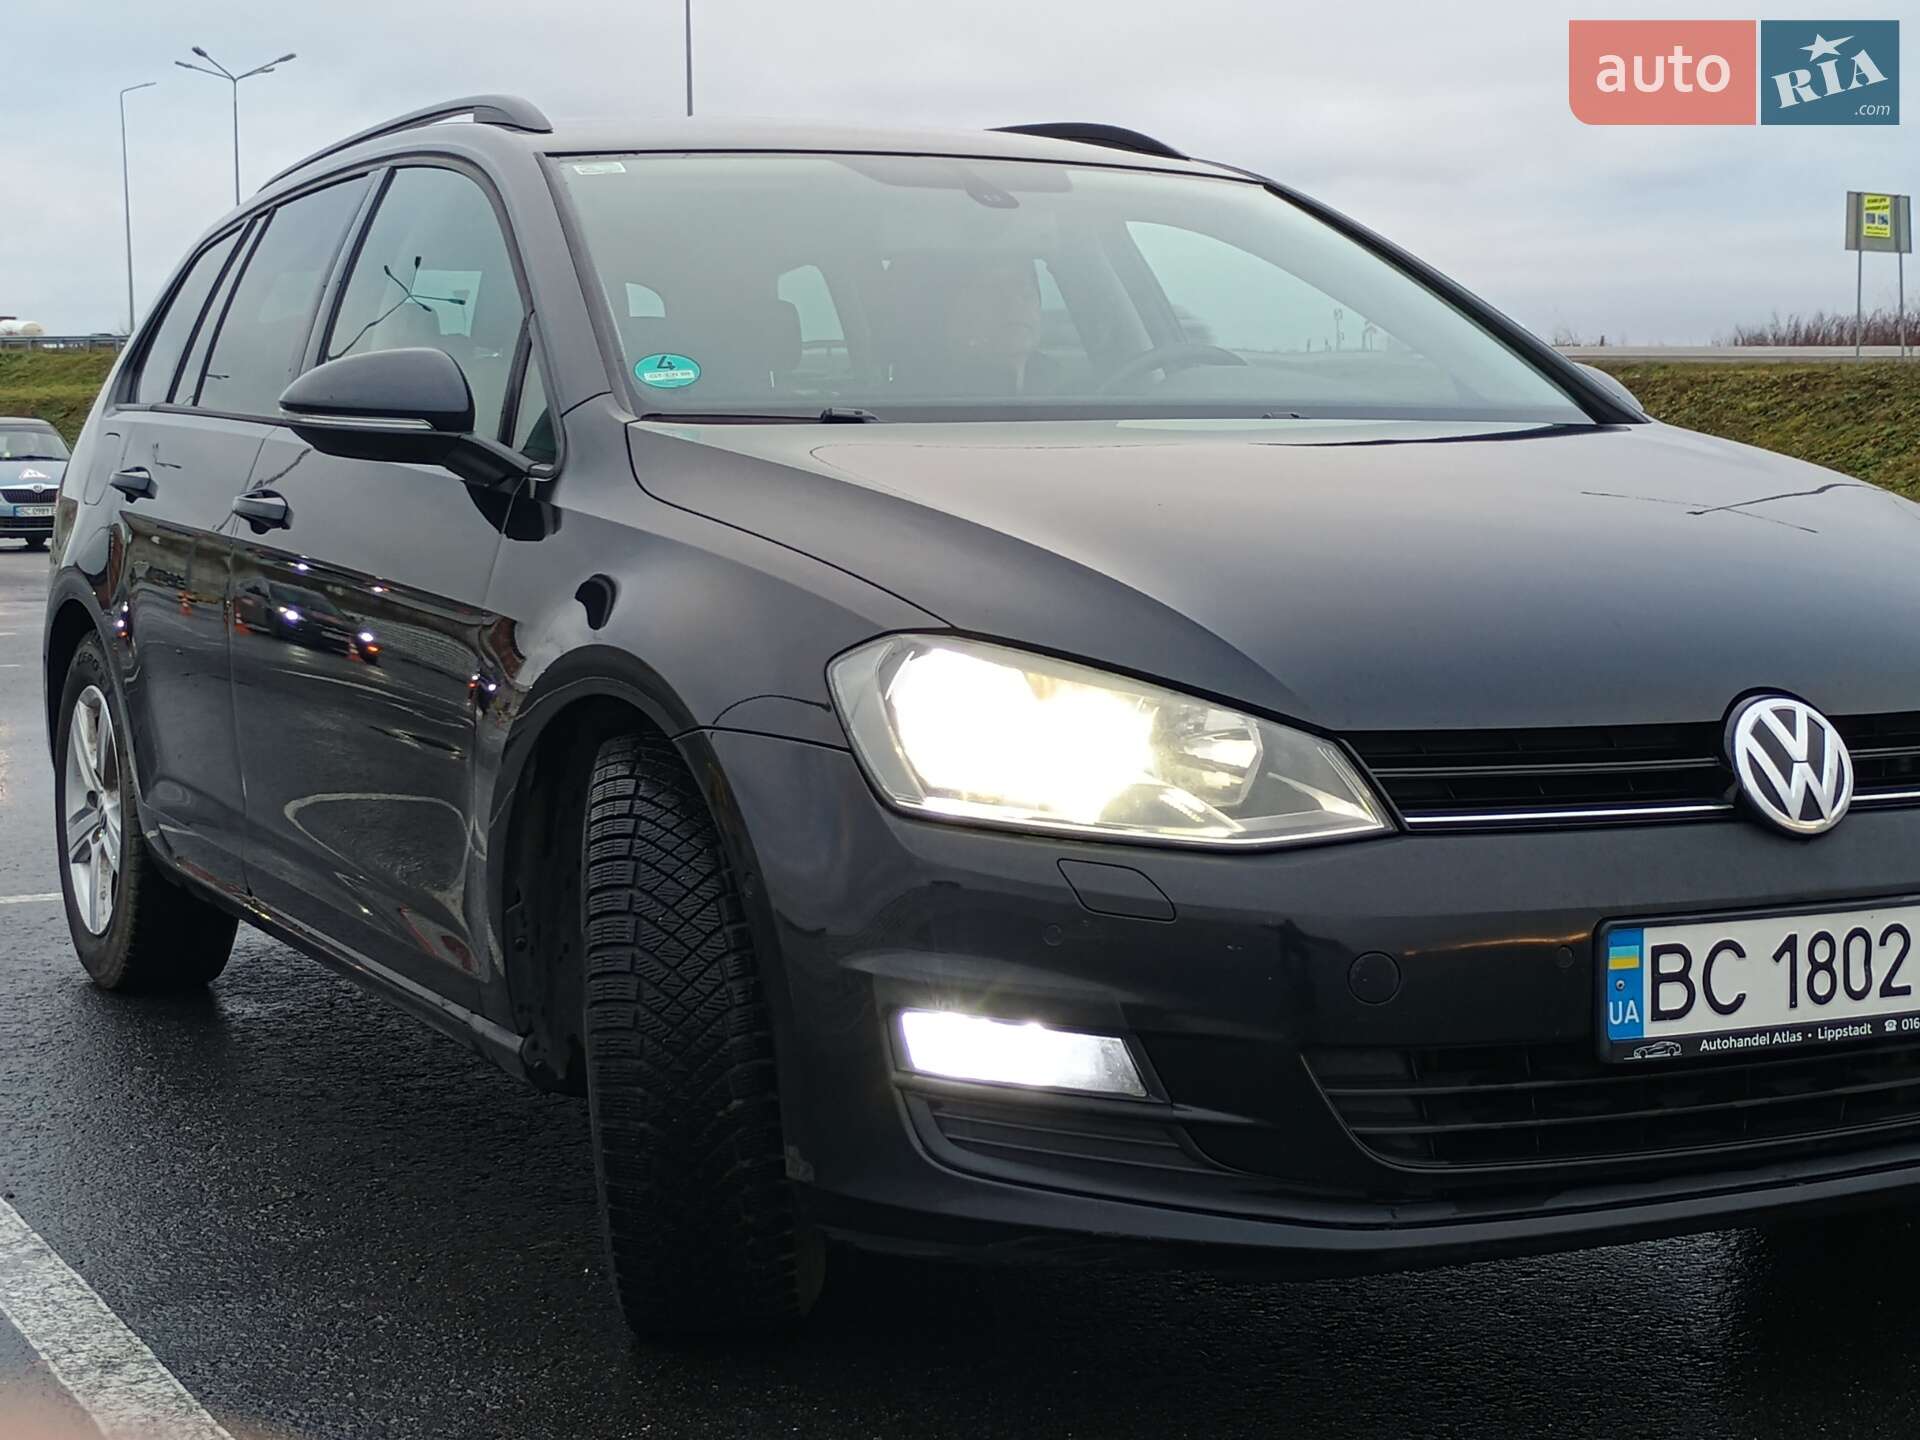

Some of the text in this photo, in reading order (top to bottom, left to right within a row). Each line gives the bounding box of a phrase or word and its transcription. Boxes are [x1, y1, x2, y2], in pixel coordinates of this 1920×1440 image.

[656, 355, 676, 370] 4
[1650, 922, 1912, 1022] BC 1802
[1609, 999, 1640, 1025] UA
[1700, 1032, 1770, 1052] Autohandel
[1772, 1029, 1803, 1045] Atlas
[1817, 1023, 1873, 1041] Lippstadt
